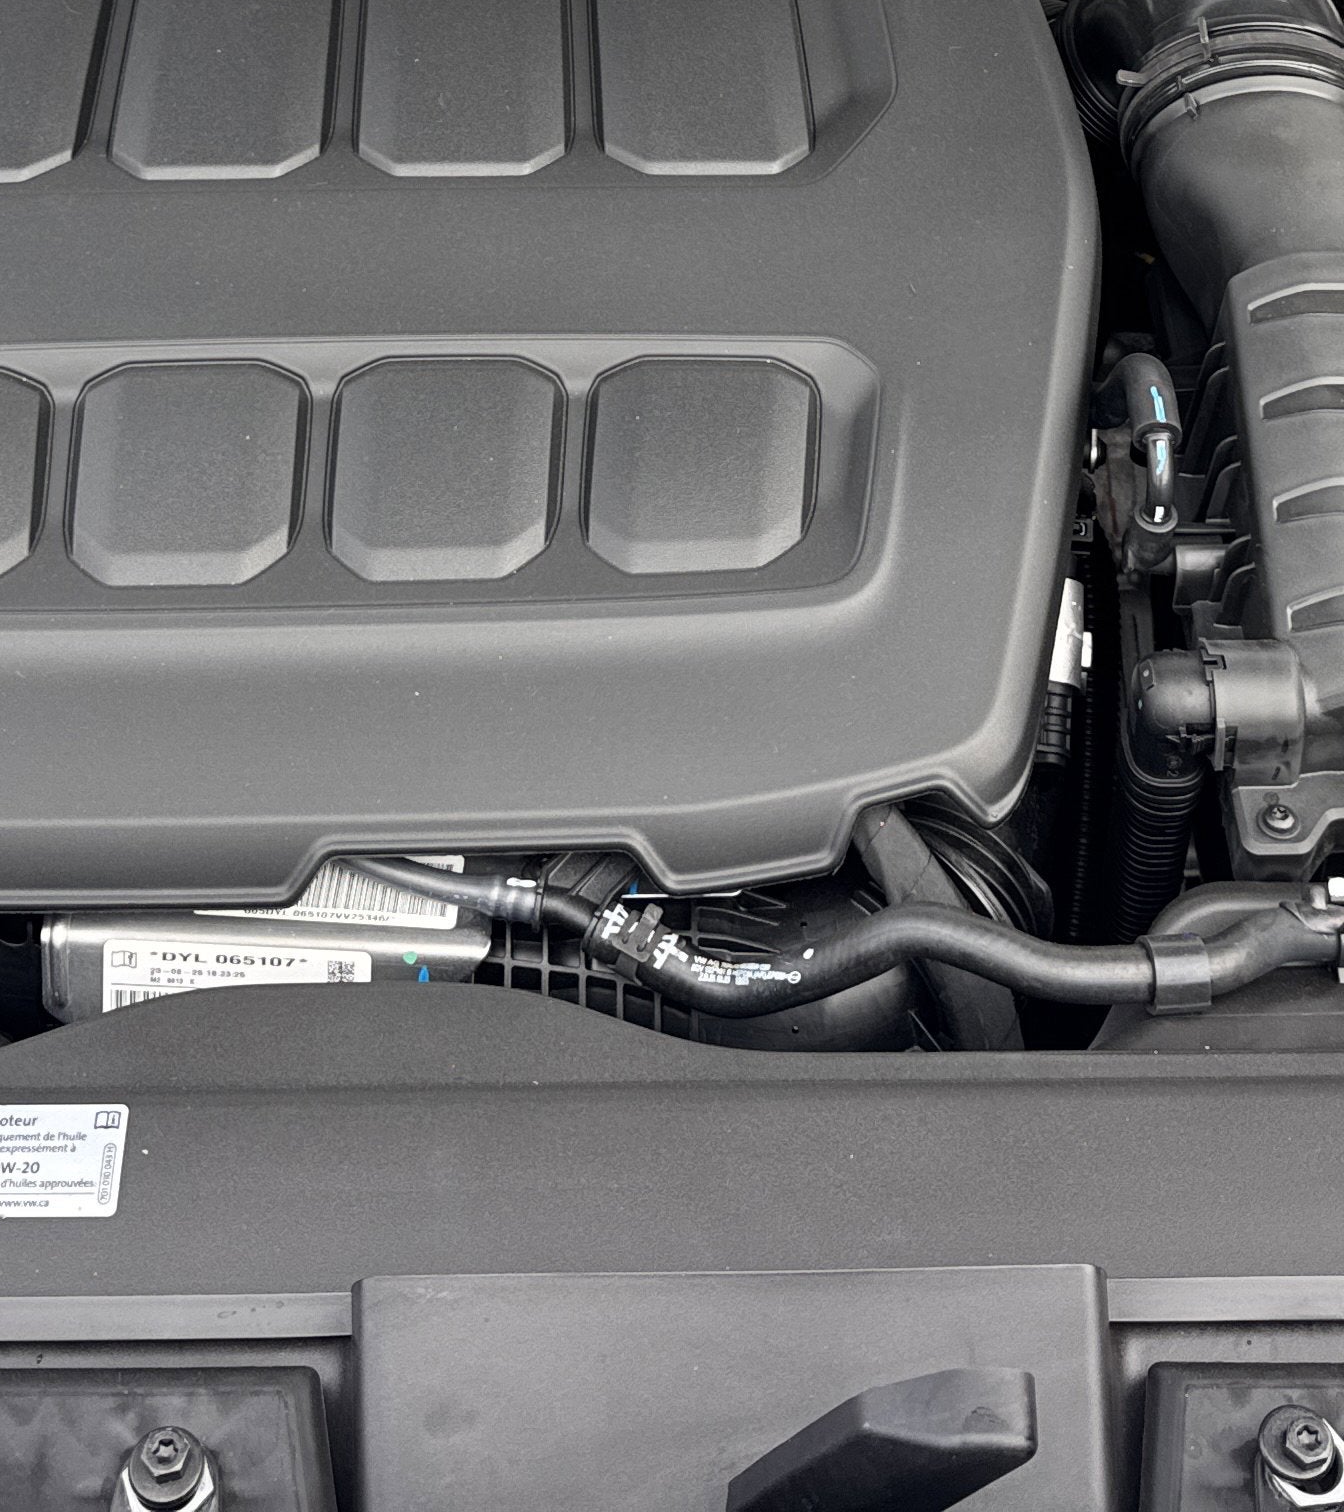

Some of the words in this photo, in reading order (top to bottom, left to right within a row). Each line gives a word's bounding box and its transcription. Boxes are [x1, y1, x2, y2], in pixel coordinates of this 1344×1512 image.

[42, 1131, 56, 1141] de
[58, 1131, 88, 1141] l'huile
[0, 1142, 68, 1154] expressément
[69, 1143, 77, 1153] à
